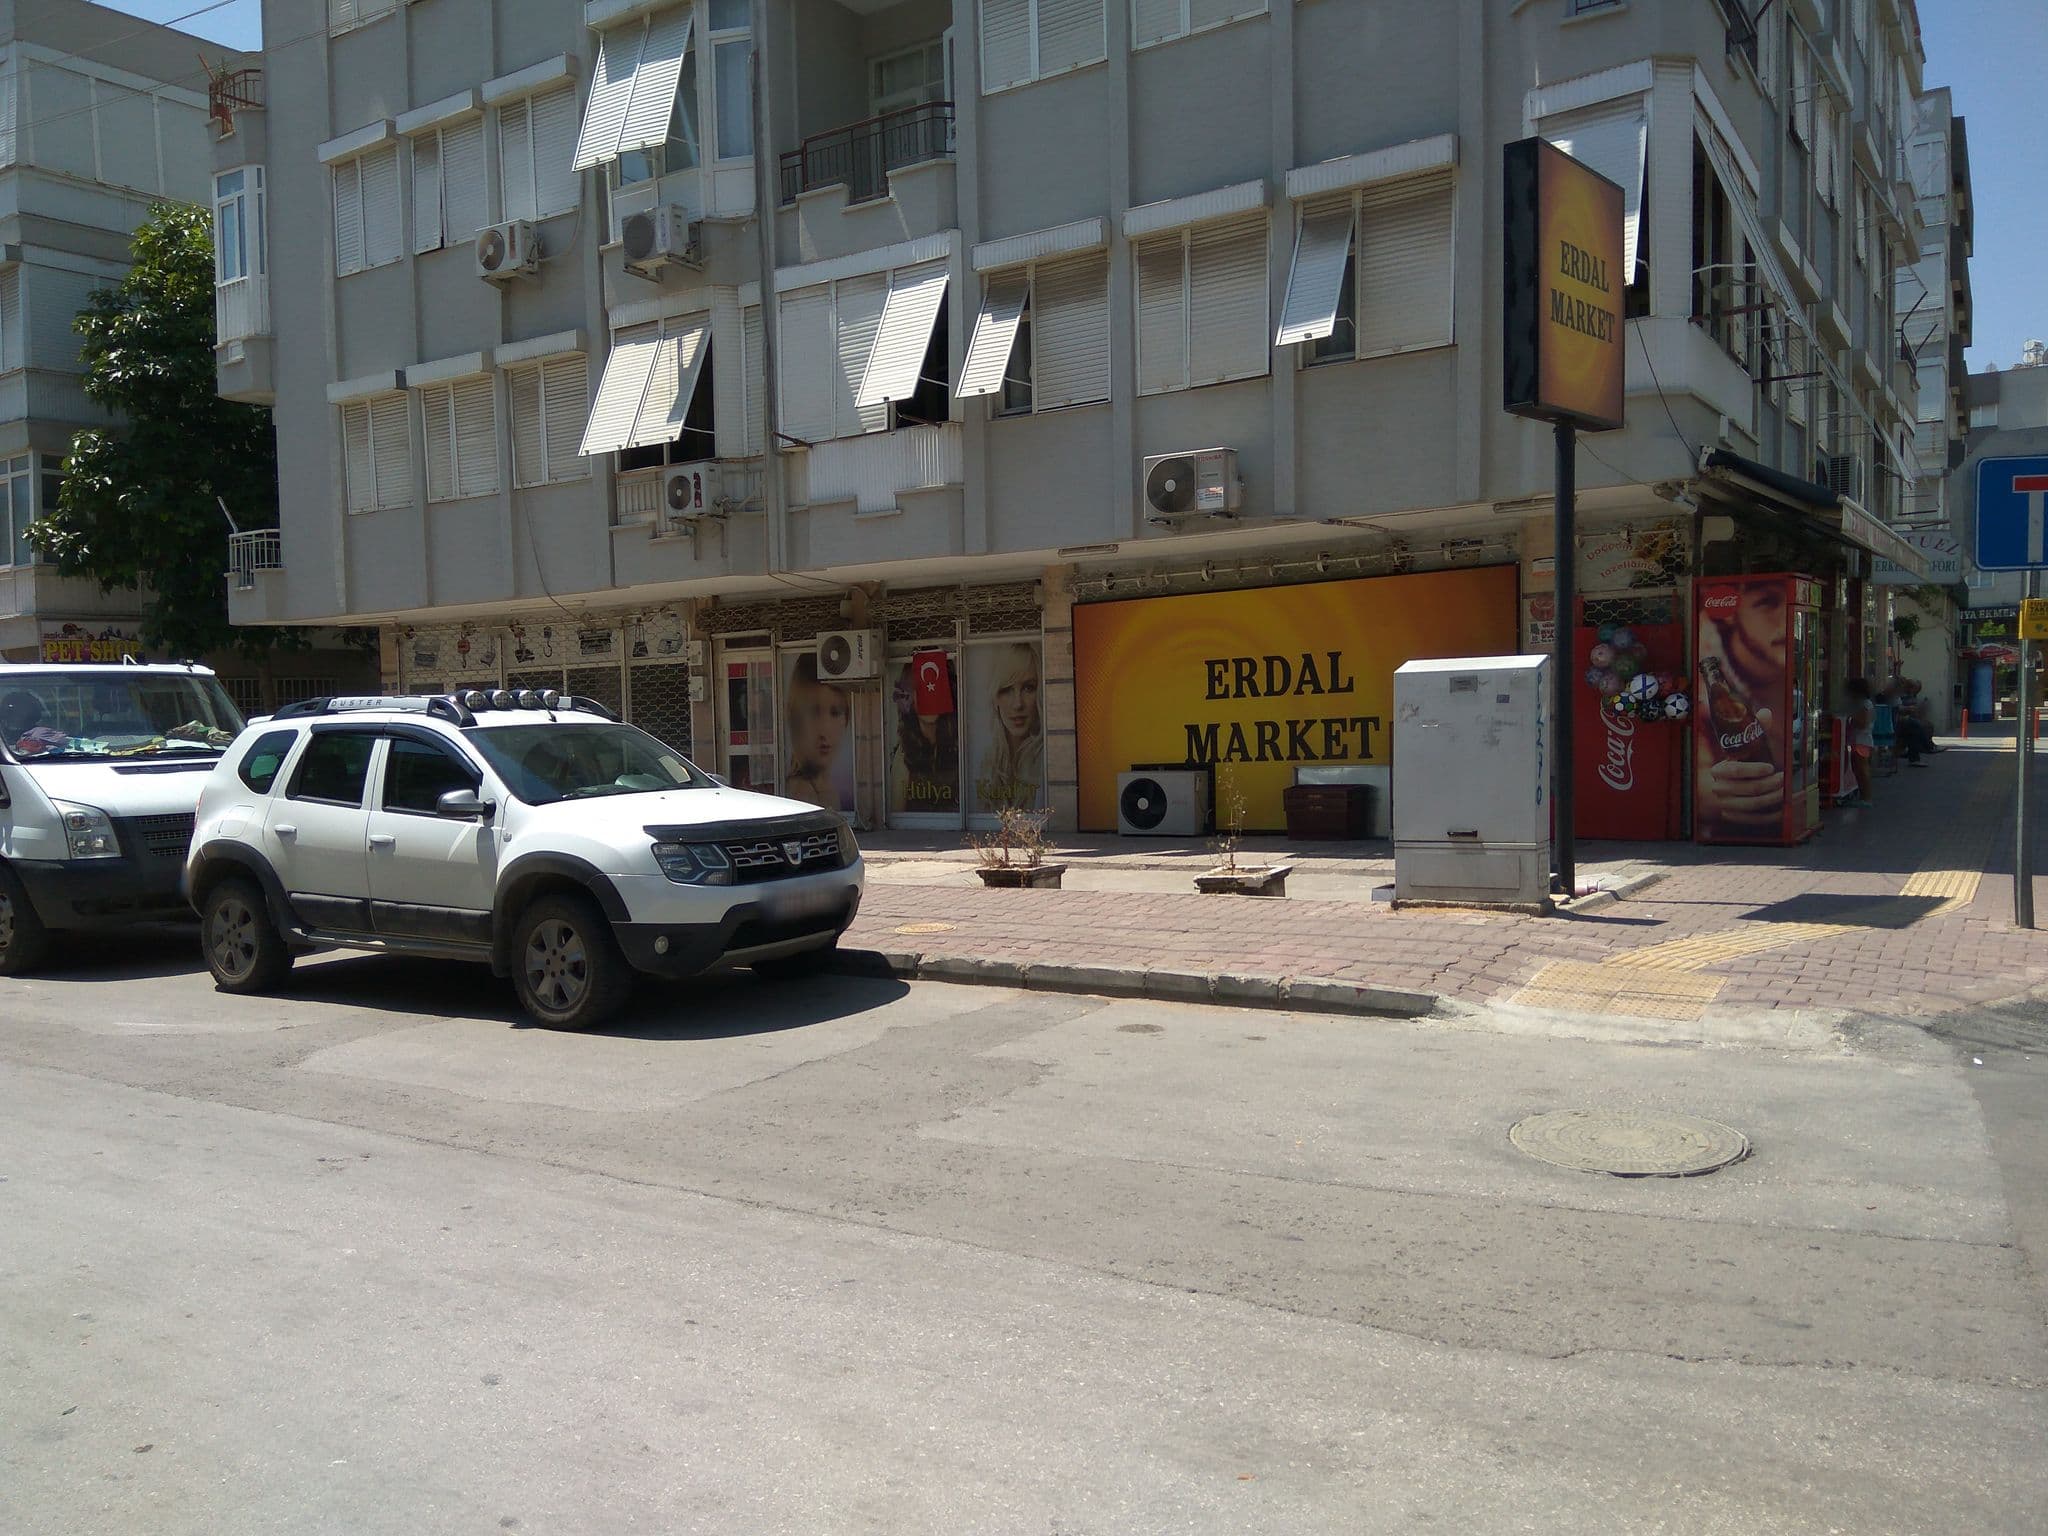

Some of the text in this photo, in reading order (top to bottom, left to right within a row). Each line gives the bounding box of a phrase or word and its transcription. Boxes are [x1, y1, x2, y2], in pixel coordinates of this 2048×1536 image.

[1560, 240, 1610, 294] ERDAL
[1550, 288, 1616, 344] MARKET
[1704, 595, 1739, 608] Coca-Cola
[43, 640, 142, 662] PET SHOP
[1205, 651, 1354, 699] ERDAL
[331, 699, 383, 707] DUSTER
[1184, 716, 1380, 764] MARKET
[903, 777, 953, 801] Hülya
